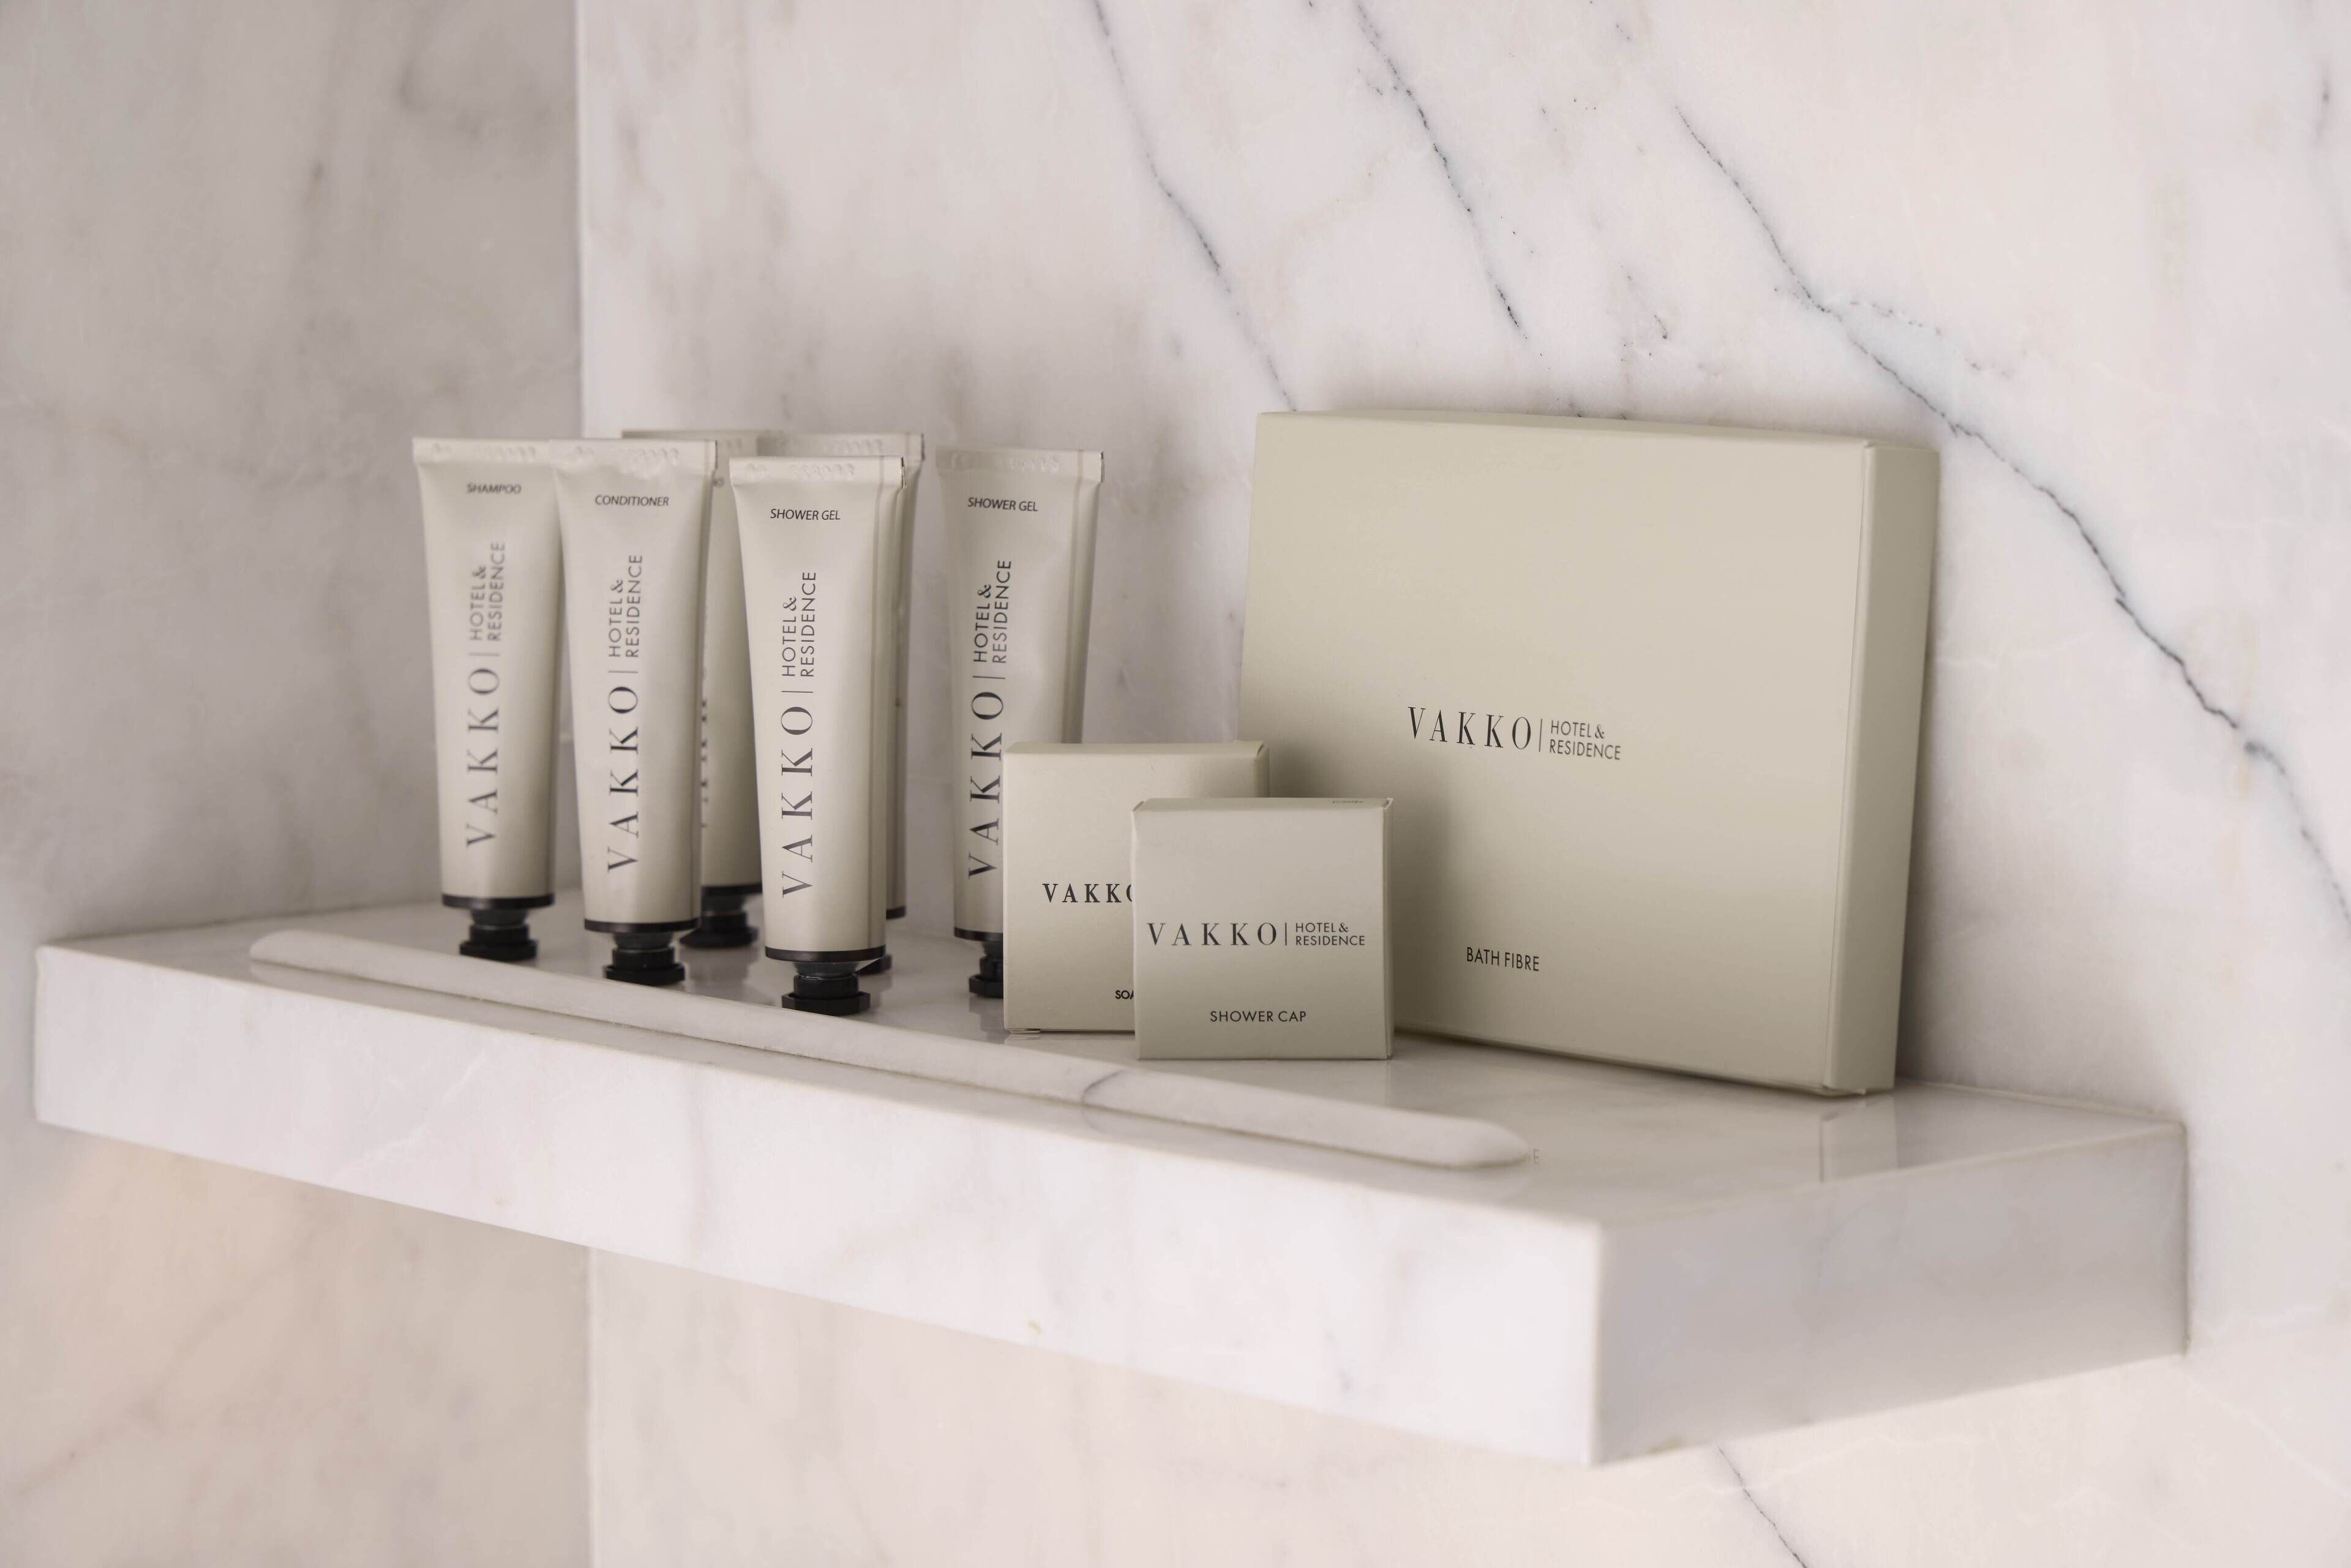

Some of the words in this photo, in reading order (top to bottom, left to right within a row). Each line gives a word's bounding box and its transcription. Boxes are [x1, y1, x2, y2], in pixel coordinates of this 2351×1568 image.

[467, 482, 522, 495] SHAMPOO
[594, 494, 670, 507] CONDITIONER
[967, 497, 1017, 511] SHOWER
[1018, 500, 1038, 512] GEL
[770, 508, 819, 520] SHOWER
[821, 509, 841, 520] GEL
[487, 543, 505, 642] RESIDENCE
[625, 555, 643, 658] RESIDENCE
[800, 572, 816, 677] RESIDENCE
[992, 560, 1012, 664] RESIDENCE
[1408, 706, 1531, 750] VAKKO
[466, 667, 499, 847] VAKKO
[1549, 738, 1621, 760] RESIDENCE
[607, 686, 639, 871] VAKKO
[968, 691, 1005, 877] VAKKO
[781, 706, 813, 898] VAKKO
[1147, 922, 1277, 946] VAKKO
[1295, 935, 1365, 946] RESIDENCE
[1466, 947, 1499, 966] BATH
[1504, 951, 1540, 972] FIBRE
[1210, 1010, 1274, 1022] SHOWER
[1278, 1010, 1307, 1022] CAP
